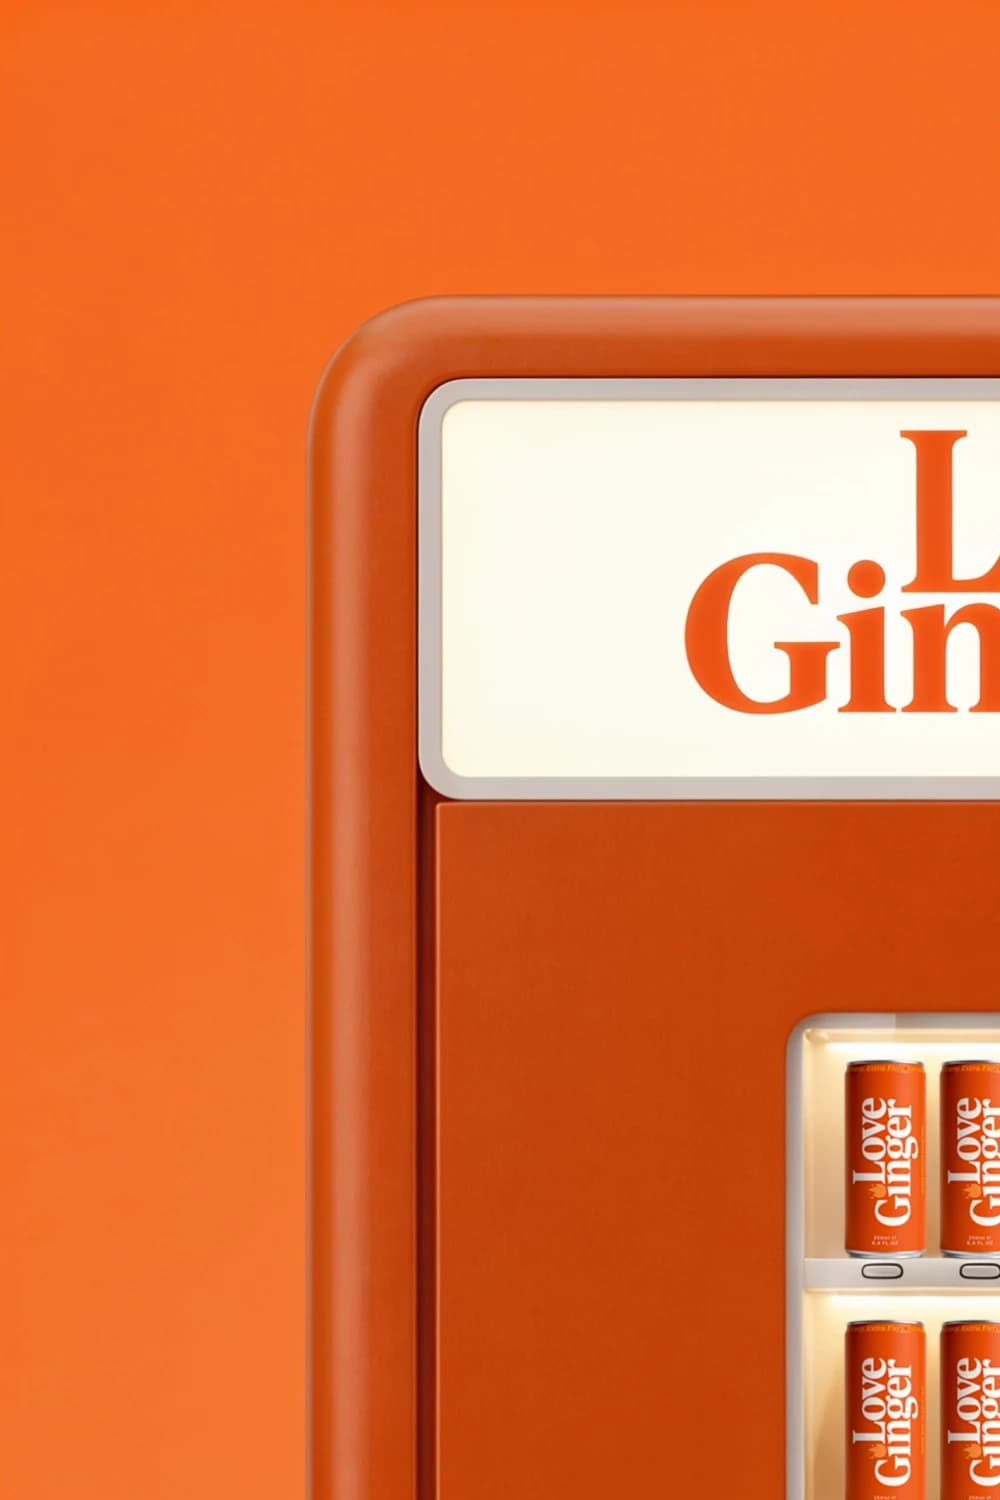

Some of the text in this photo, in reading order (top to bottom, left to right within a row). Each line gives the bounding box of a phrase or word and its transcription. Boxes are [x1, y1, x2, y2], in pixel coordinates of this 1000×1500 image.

[853, 1097, 887, 1184] Love
[874, 1098, 919, 1227] Ginger
[948, 1097, 982, 1184] Love
[853, 1357, 887, 1444] Love
[874, 1358, 919, 1487] Ginger
[948, 1357, 982, 1444] Love
